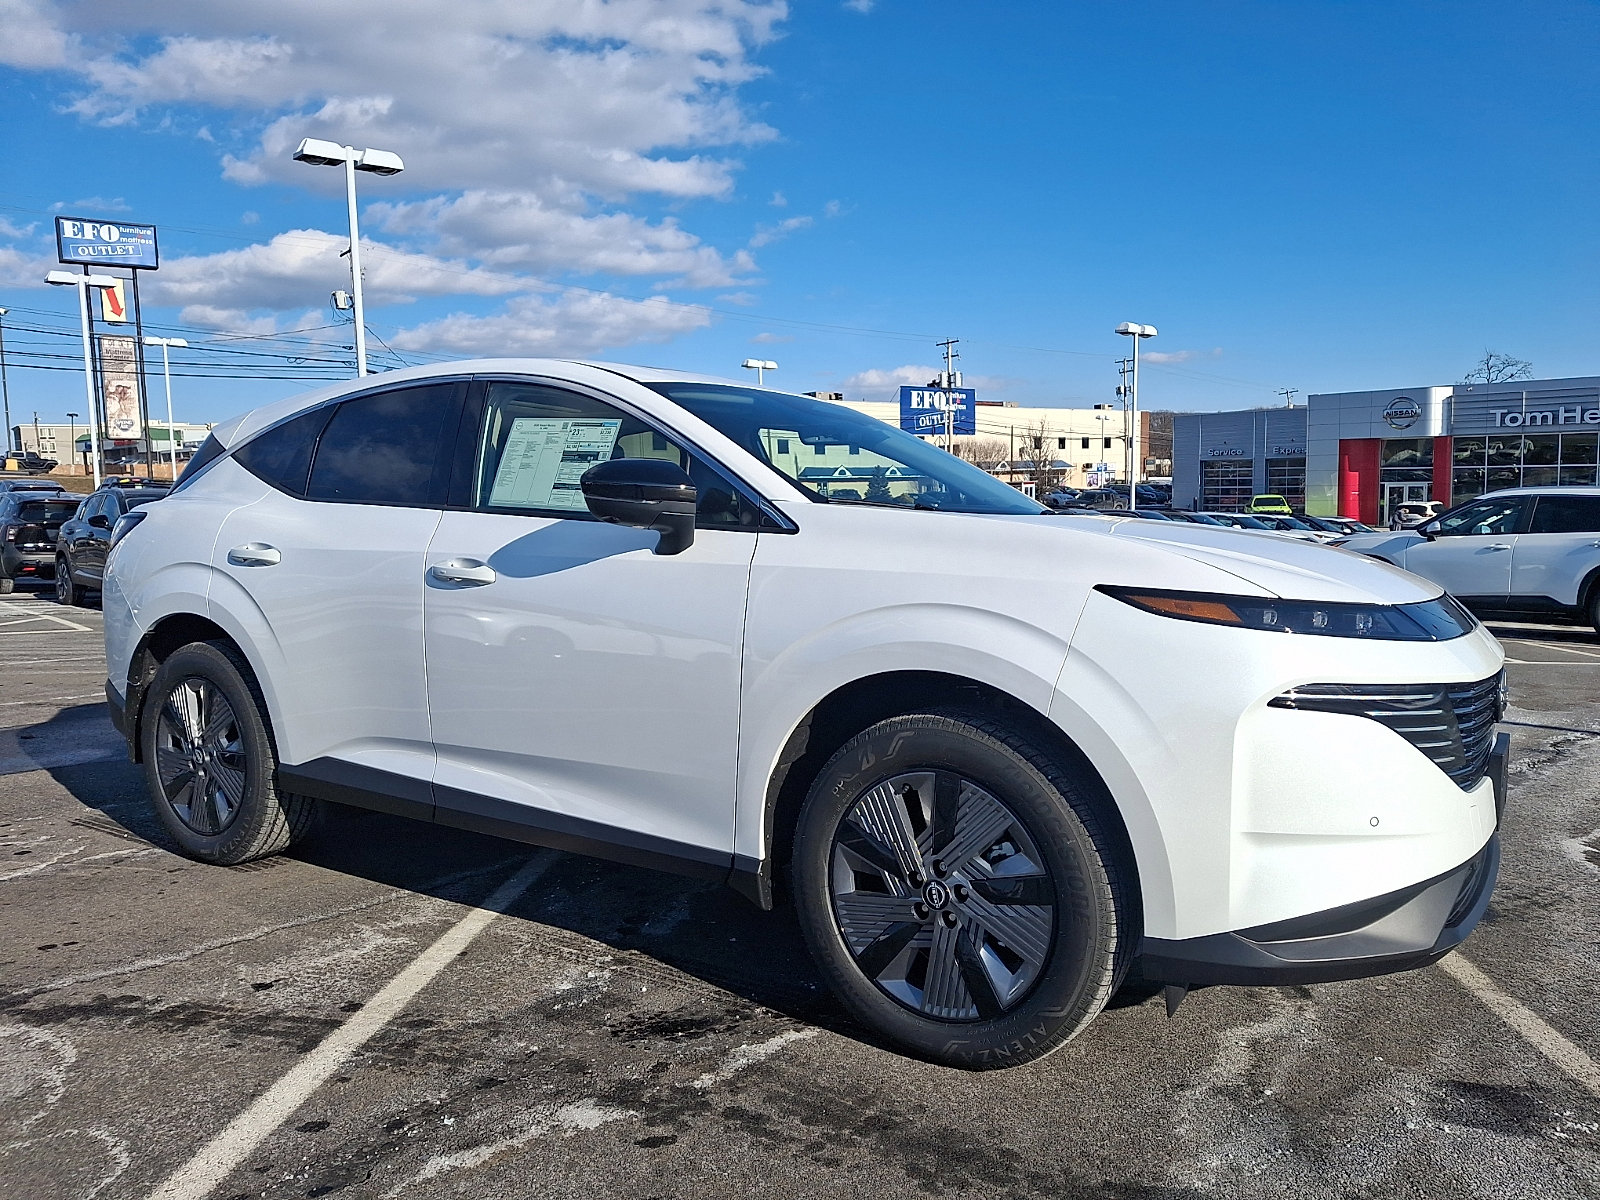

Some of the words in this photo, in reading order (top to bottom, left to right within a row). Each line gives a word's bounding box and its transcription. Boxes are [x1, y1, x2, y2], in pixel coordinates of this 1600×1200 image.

[61, 220, 120, 243] EFO
[119, 226, 152, 236] furniture
[120, 236, 153, 245] mattress
[77, 244, 135, 256] OUTLET
[910, 390, 946, 410] EFO
[1385, 409, 1418, 417] NISSAN
[1489, 409, 1553, 427] Tom
[1207, 448, 1244, 456] Service
[959, 1021, 1048, 1061] ALENZA
